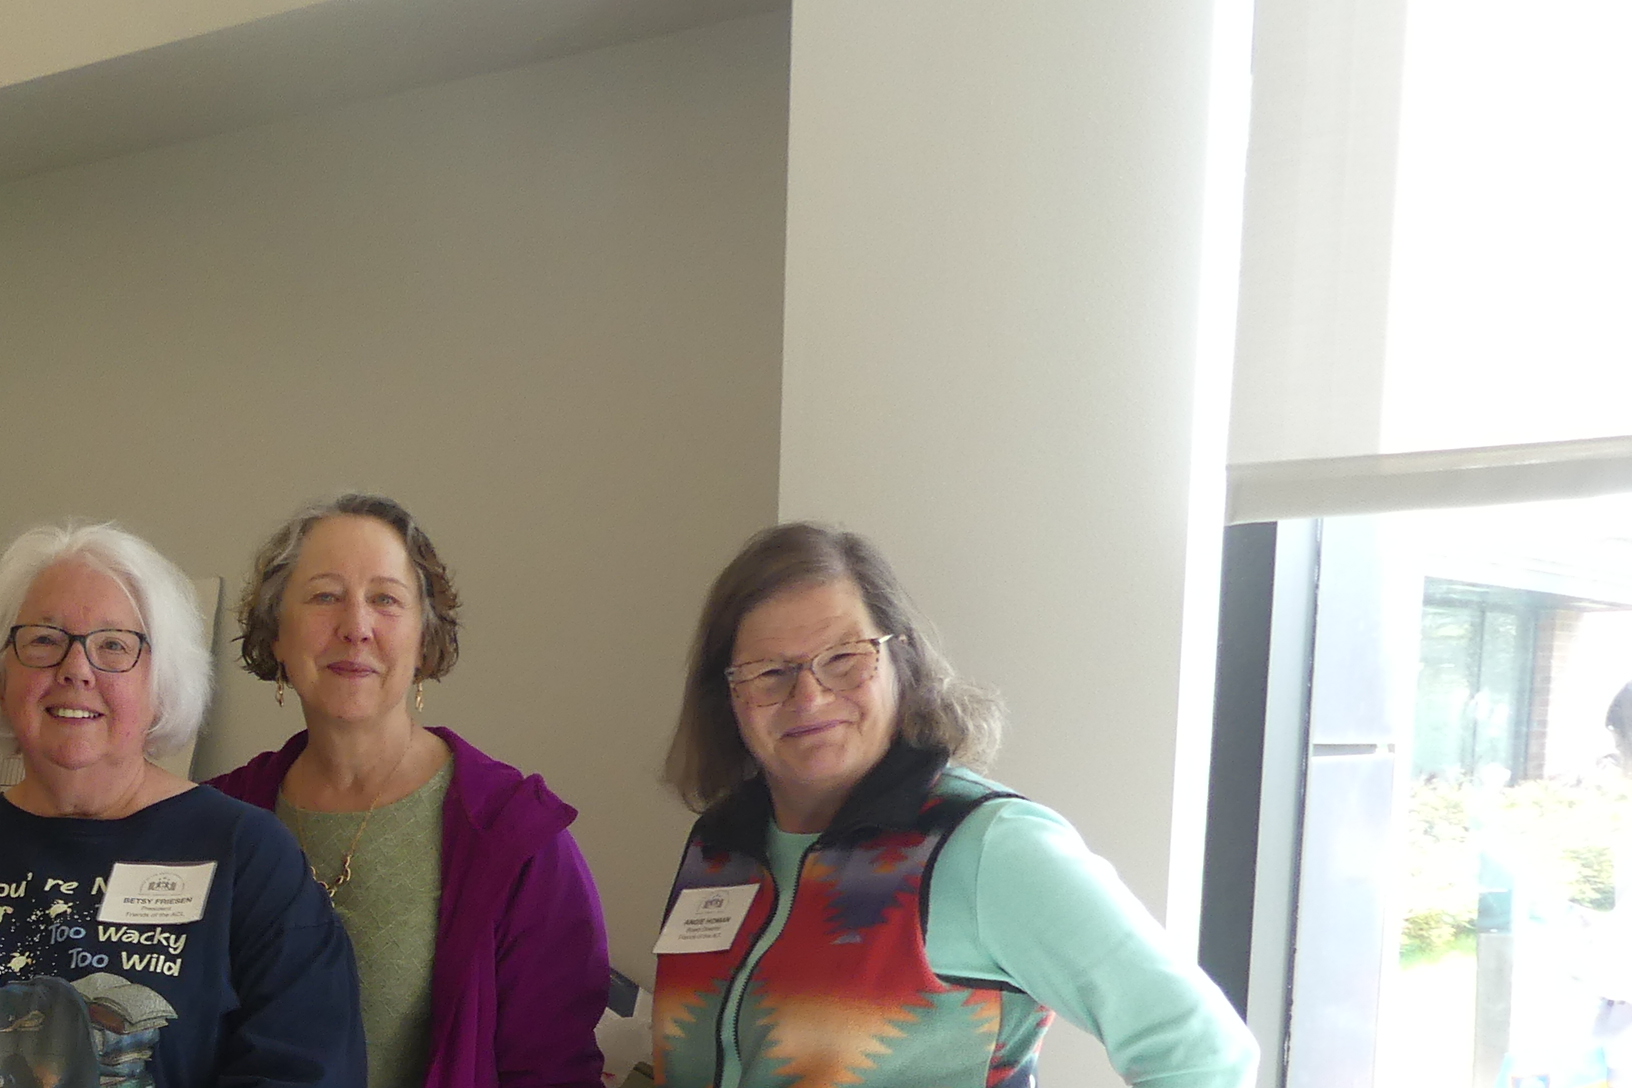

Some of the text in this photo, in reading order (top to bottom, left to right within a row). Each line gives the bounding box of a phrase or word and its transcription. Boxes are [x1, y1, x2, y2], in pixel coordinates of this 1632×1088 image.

[154, 896, 193, 904] FRIESEN
[49, 923, 187, 955] Too Wacky
[68, 948, 182, 977] Too Wild
